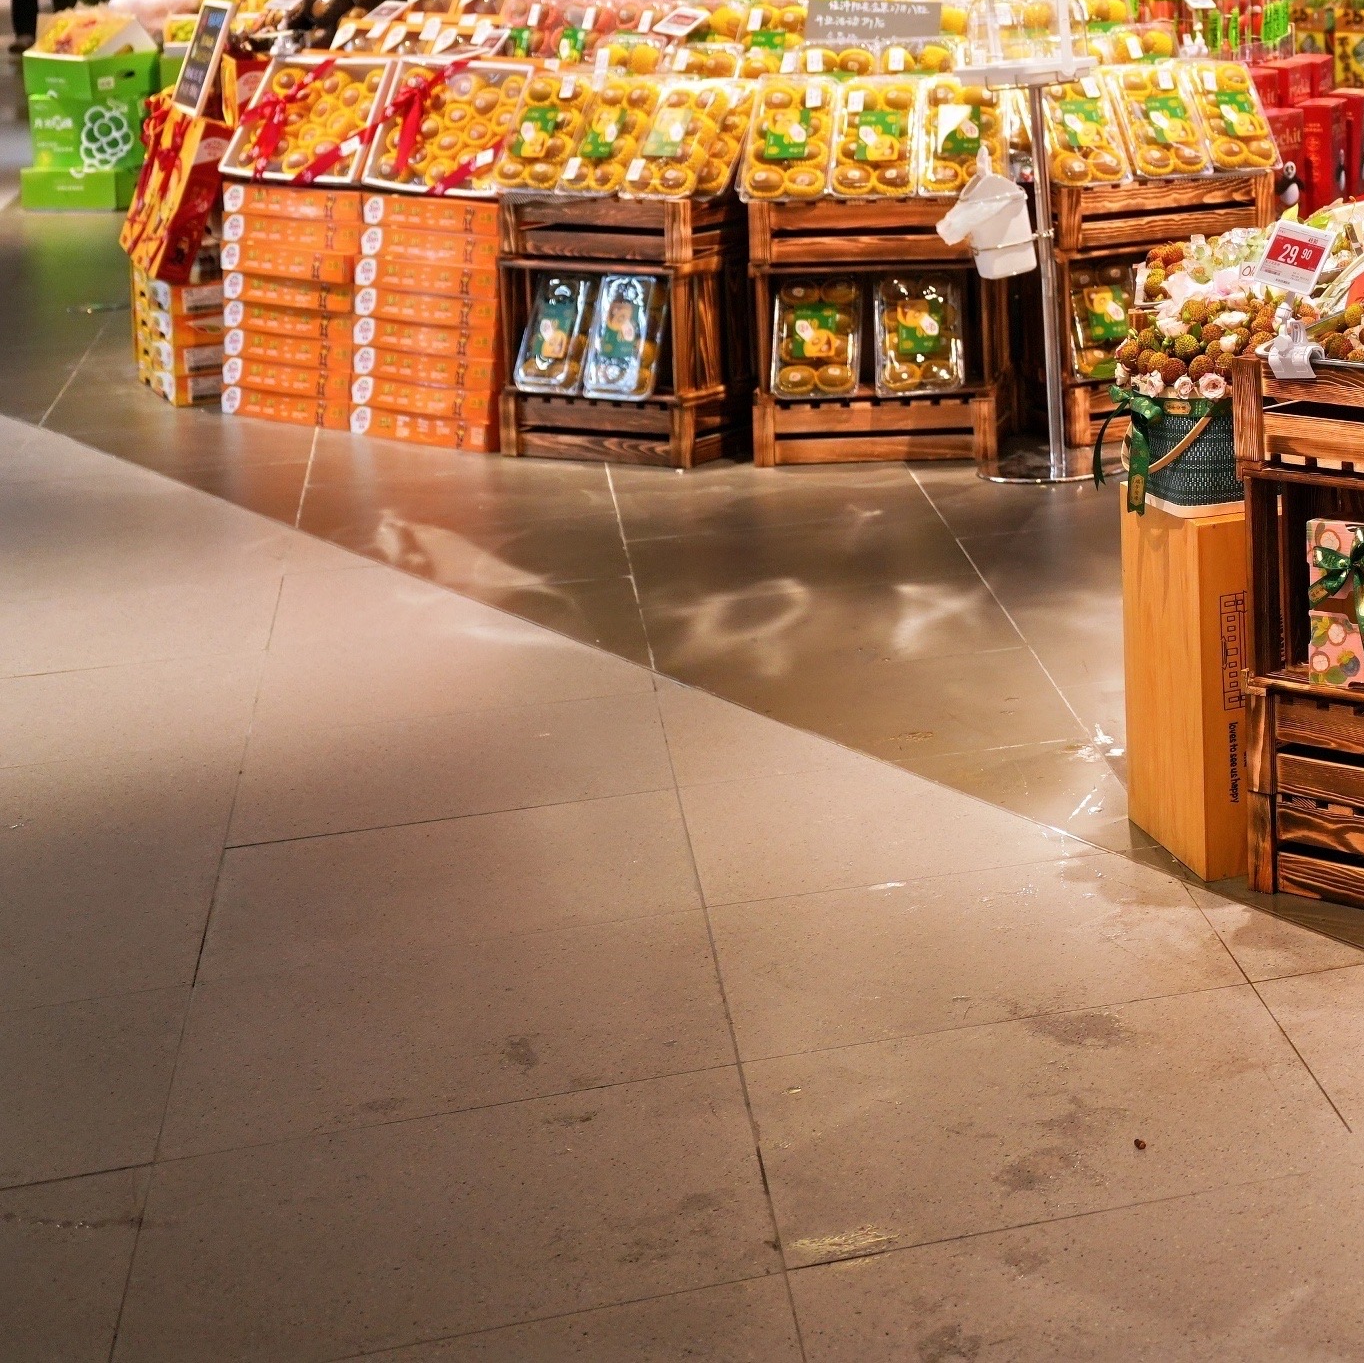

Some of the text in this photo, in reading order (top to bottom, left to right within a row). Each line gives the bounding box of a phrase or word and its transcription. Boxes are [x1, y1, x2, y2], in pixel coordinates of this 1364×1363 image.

[1278, 242, 1313, 267] 29.90
[1228, 722, 1238, 744] loves
[1231, 778, 1239, 803] happy
